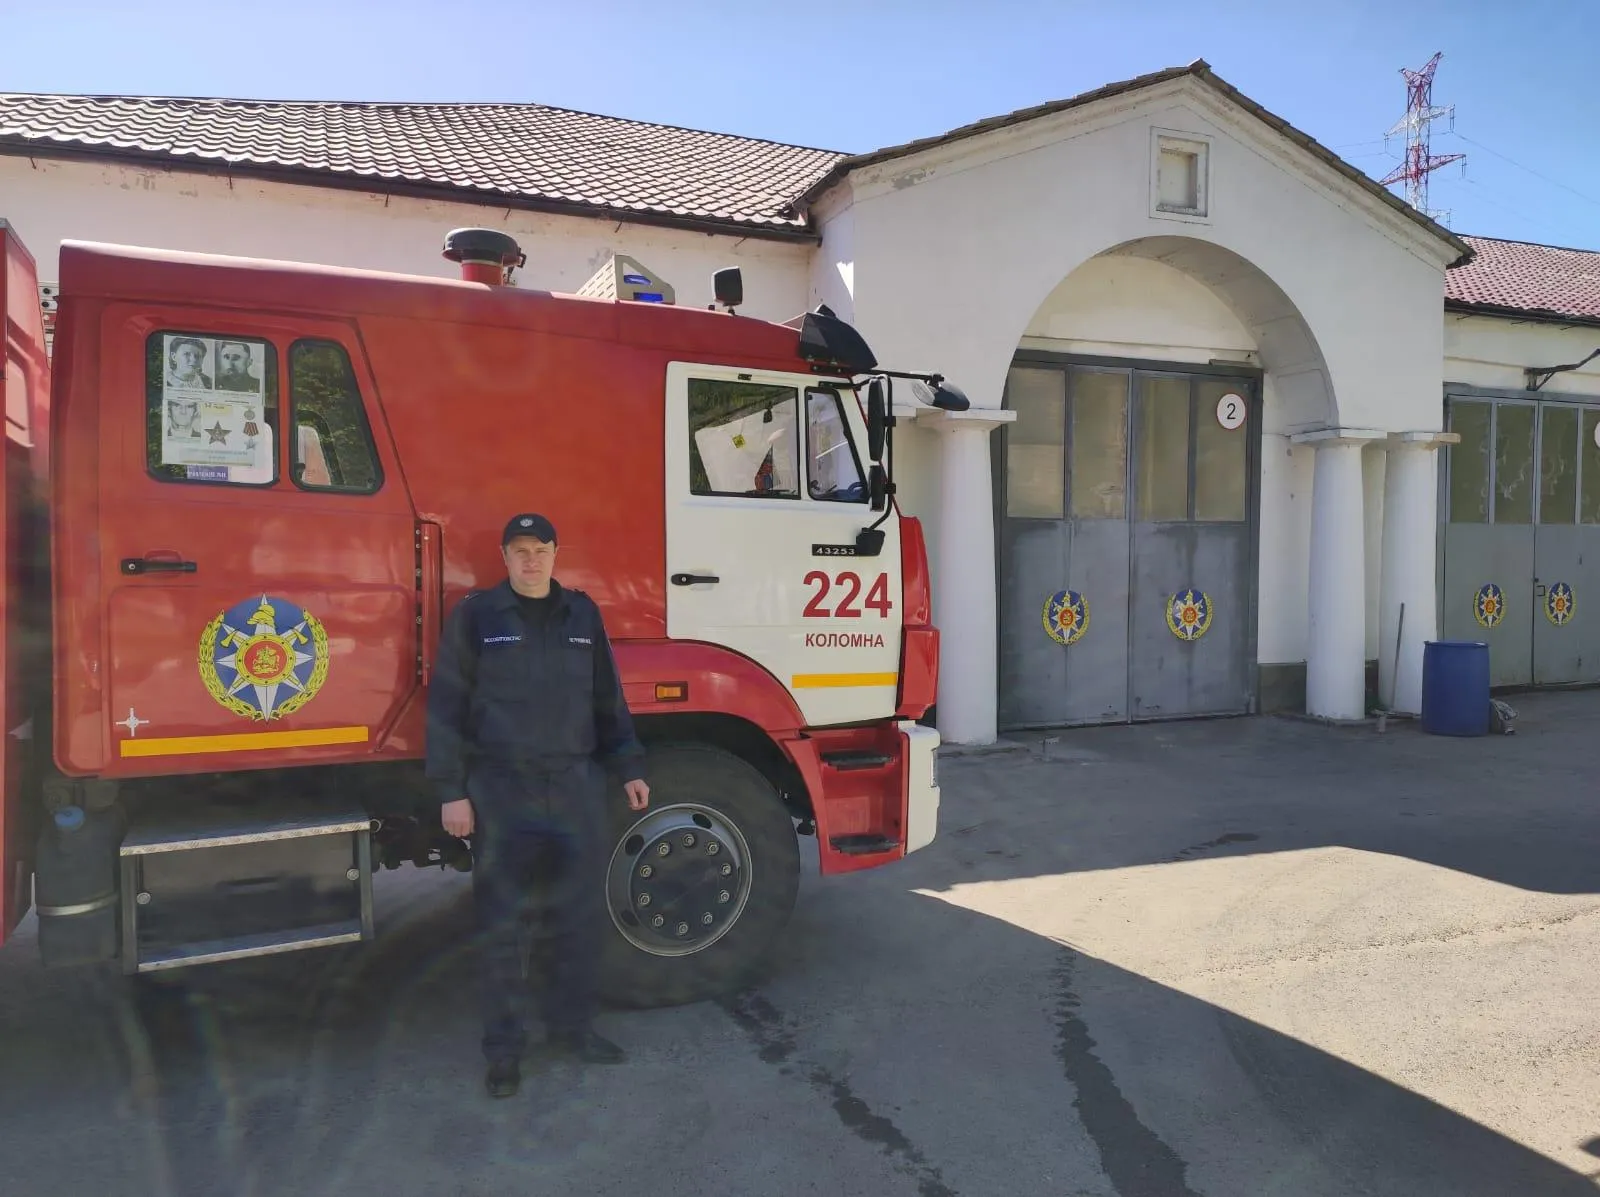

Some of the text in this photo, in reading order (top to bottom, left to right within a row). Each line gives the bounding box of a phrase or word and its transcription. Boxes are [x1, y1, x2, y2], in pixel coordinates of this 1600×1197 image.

[1226, 402, 1236, 420] 2
[816, 546, 856, 555] 43253
[802, 570, 893, 618] 224
[805, 633, 885, 648] КОЛОМНА
